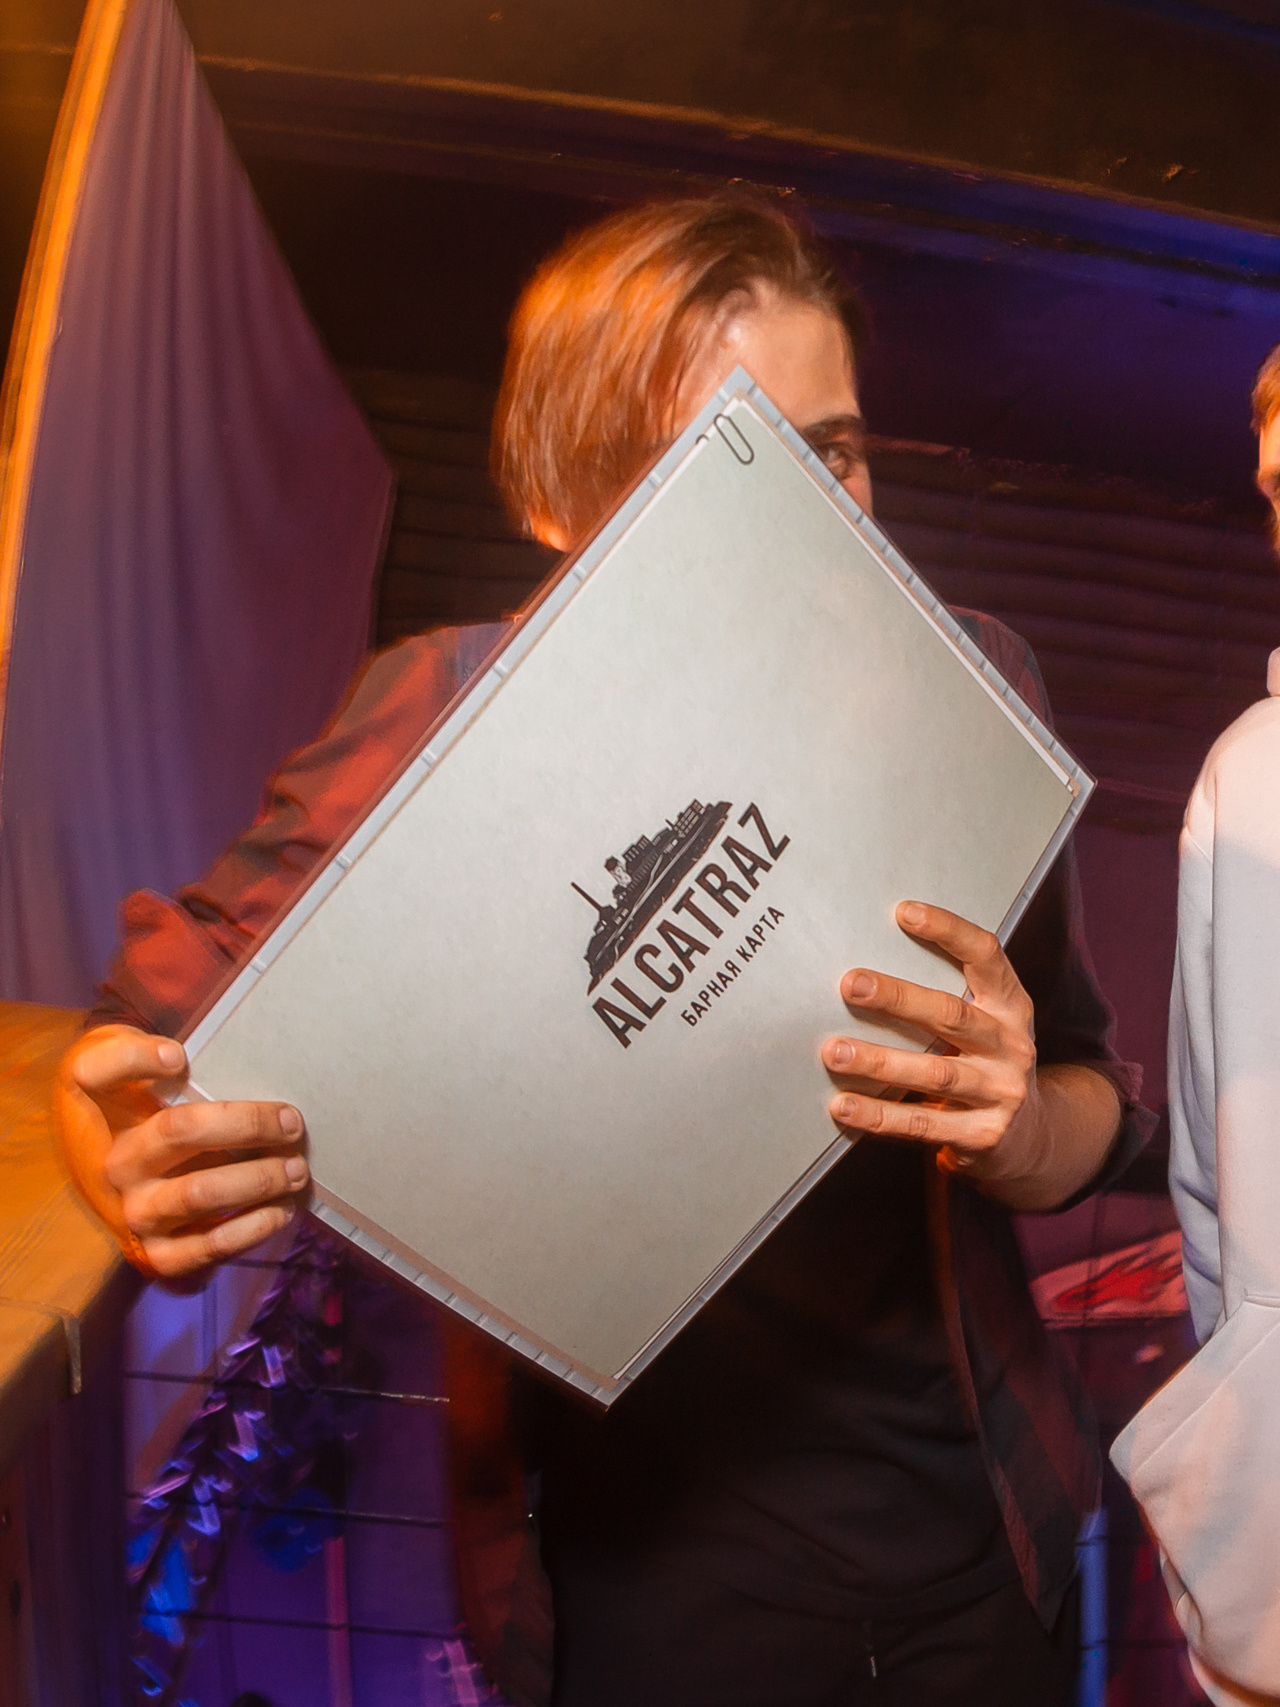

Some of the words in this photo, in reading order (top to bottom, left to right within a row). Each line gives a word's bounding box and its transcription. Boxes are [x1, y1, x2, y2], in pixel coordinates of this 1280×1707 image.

[592, 802, 791, 1049] ALCATRAZ
[680, 959, 742, 1027] БАРНАЯ
[735, 906, 785, 963] КАРТА
